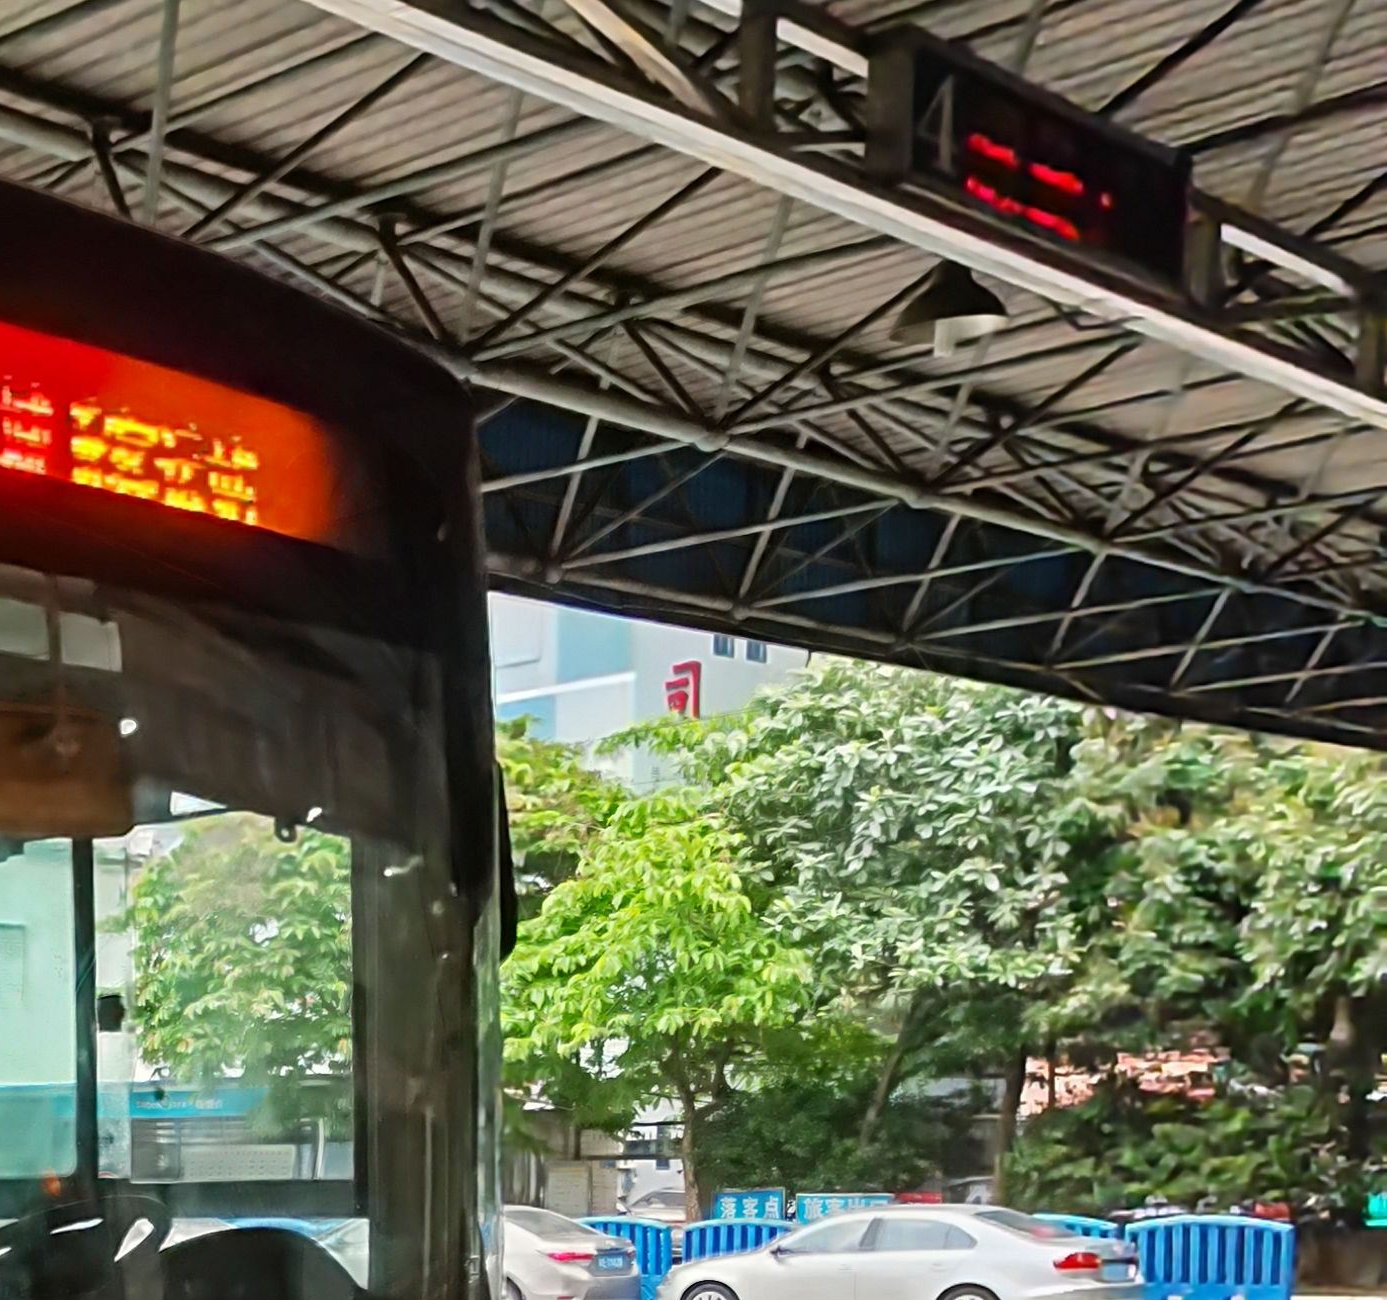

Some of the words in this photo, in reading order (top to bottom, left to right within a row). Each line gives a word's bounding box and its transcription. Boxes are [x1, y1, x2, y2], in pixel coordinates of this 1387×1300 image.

[918, 74, 957, 175] 4
[719, 1195, 780, 1220] 落客点
